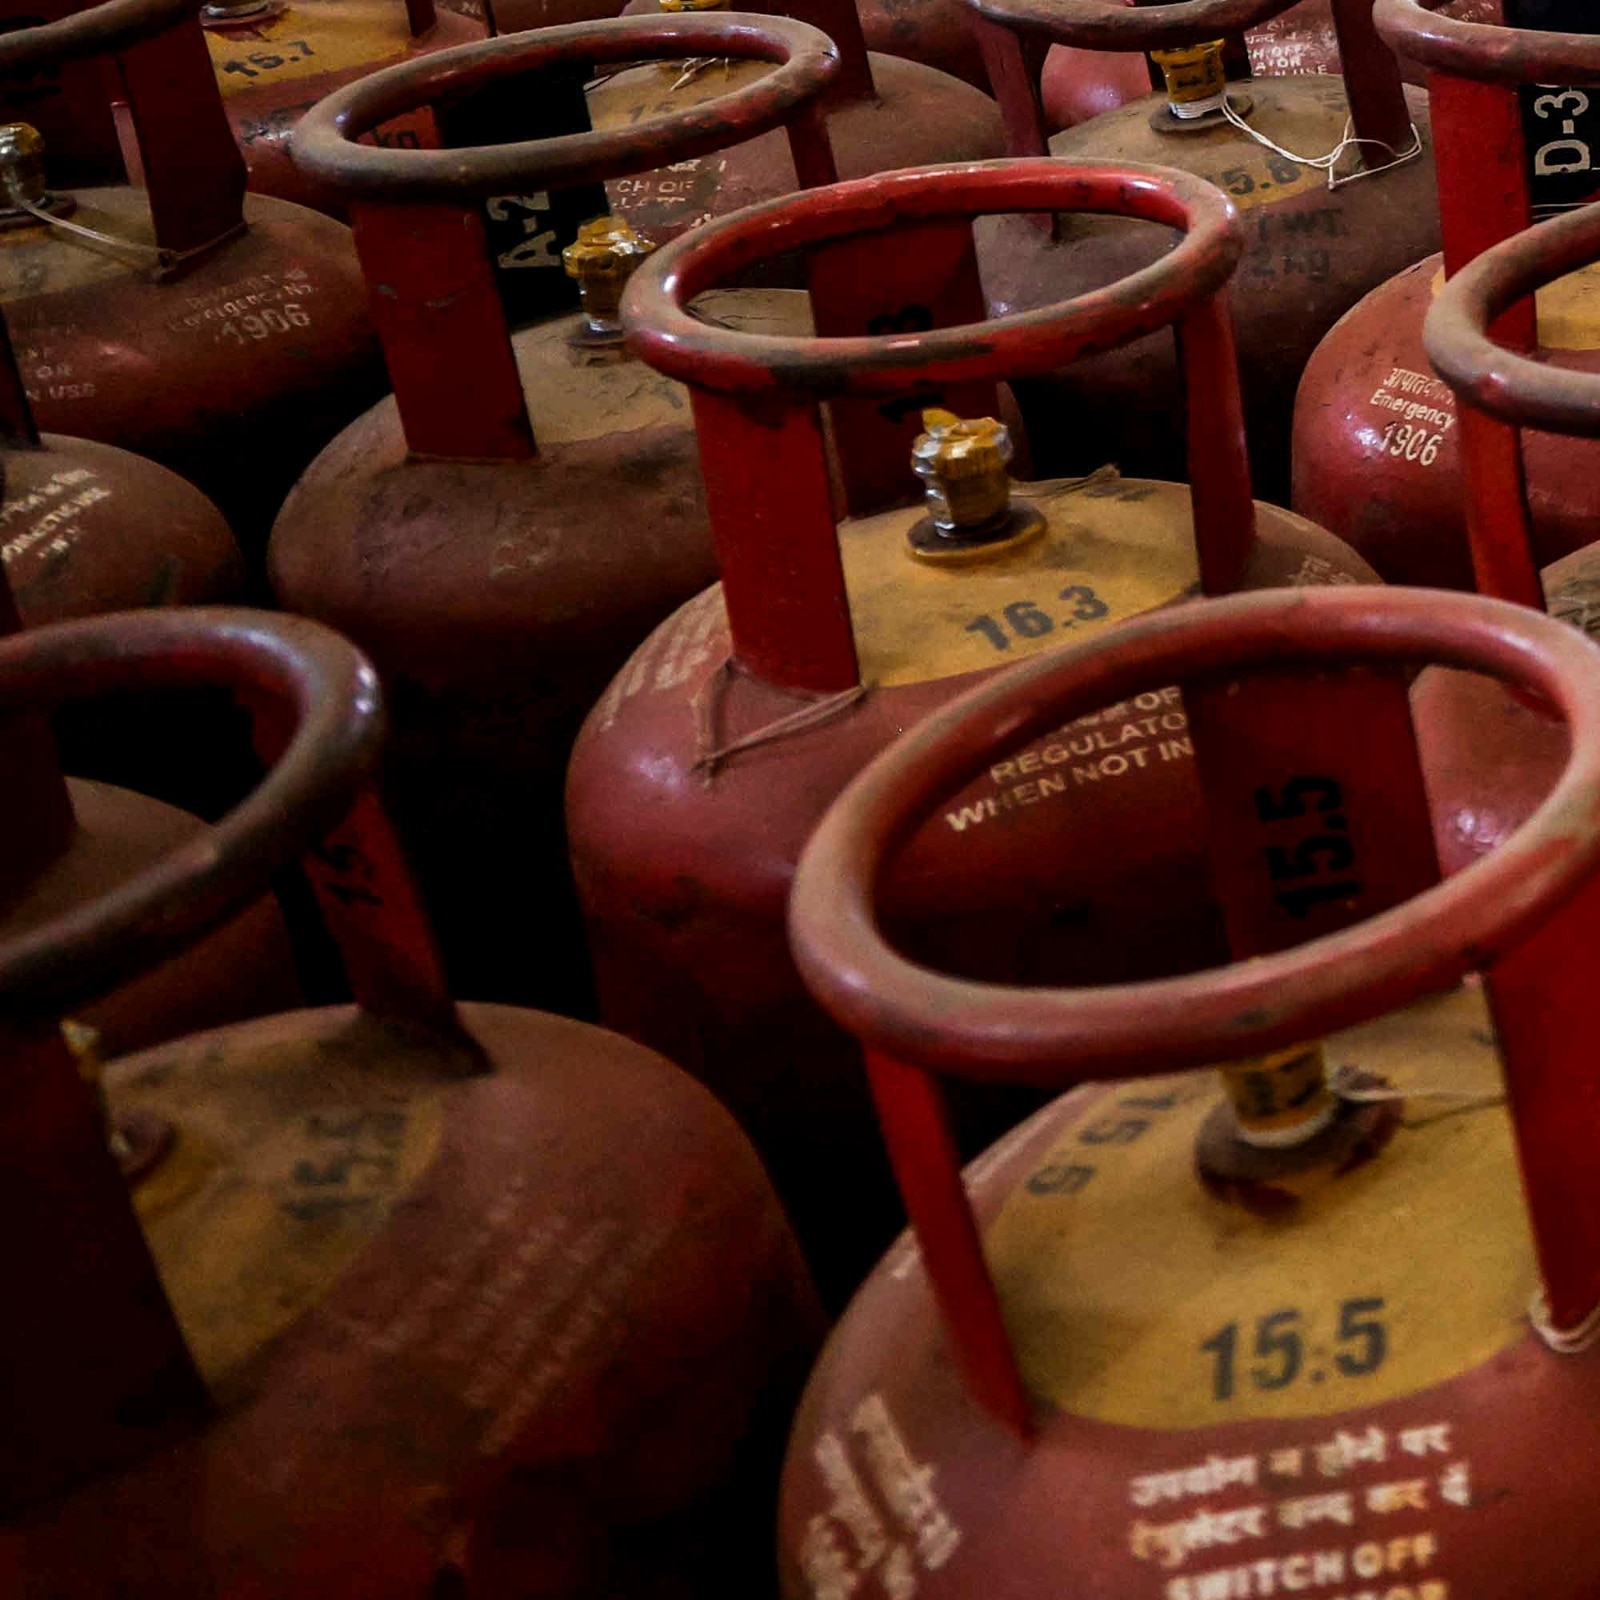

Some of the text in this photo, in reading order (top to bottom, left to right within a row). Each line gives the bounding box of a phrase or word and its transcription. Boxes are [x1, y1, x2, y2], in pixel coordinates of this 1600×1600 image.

[1533, 84, 1591, 177] D-3
[486, 188, 563, 269] A-2
[1369, 387, 1457, 433] Emergency
[1379, 421, 1444, 467] 1906
[963, 584, 1110, 650] 16.3
[1134, 684, 1184, 711] OF
[989, 711, 1187, 784] REGULATO
[1071, 747, 1151, 785] NOT
[1256, 777, 1360, 917] 15.5
[1202, 1295, 1391, 1402] 15.5
[1164, 1550, 1348, 1600] SWITCH
[1351, 1531, 1436, 1580] OFF
